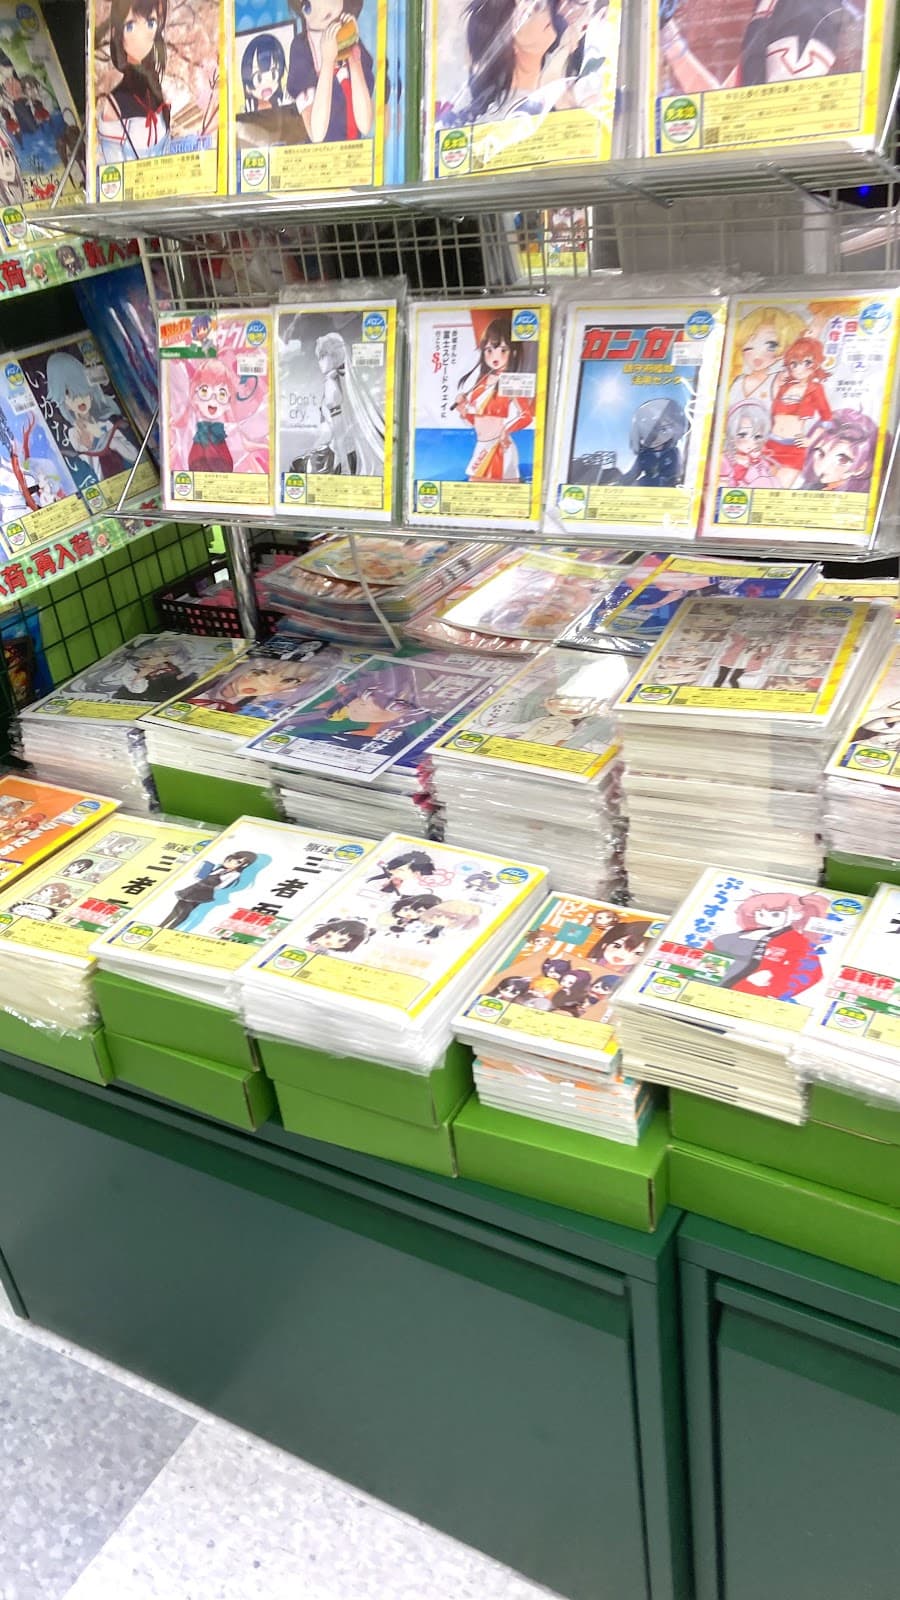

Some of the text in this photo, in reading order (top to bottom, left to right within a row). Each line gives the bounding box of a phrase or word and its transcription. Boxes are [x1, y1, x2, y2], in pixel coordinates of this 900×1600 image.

[0, 259, 27, 293] 荷
[580, 327, 684, 361] カンカ
[289, 393, 317, 406] Don't
[0, 531, 93, 596] 荷・再入荷
[106, 856, 175, 906] 三者
[839, 967, 897, 990] 最新作
